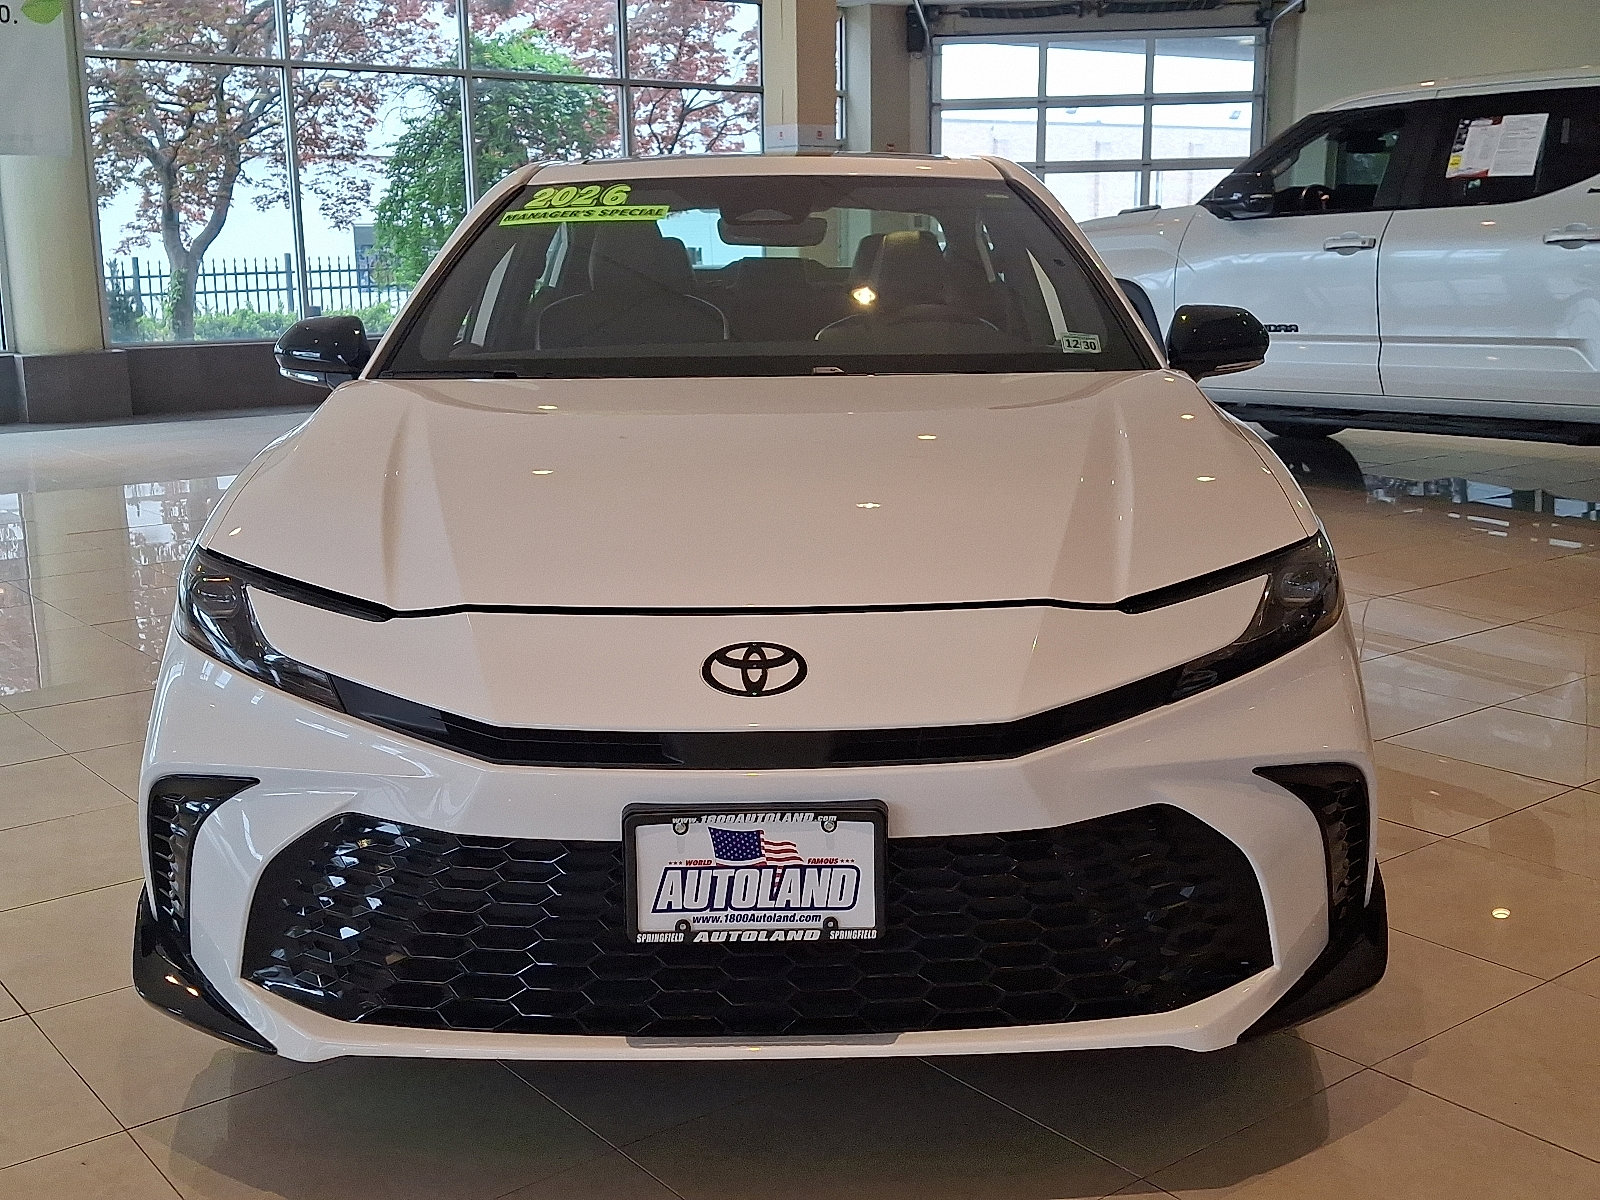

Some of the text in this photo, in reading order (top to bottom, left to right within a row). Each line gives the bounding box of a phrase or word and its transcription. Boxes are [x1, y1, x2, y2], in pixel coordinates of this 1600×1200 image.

[524, 183, 632, 209] 2026
[503, 207, 664, 222] MANAGER'S SPECIAL
[1065, 338, 1097, 351] 12 30
[807, 857, 839, 865] FAMOUS
[652, 865, 860, 913] AUTOLAND
[692, 912, 822, 924] www.1800Autoland.com
[636, 929, 877, 943] SPRINGFIELD AUTOLAND SPRINGFIELD
